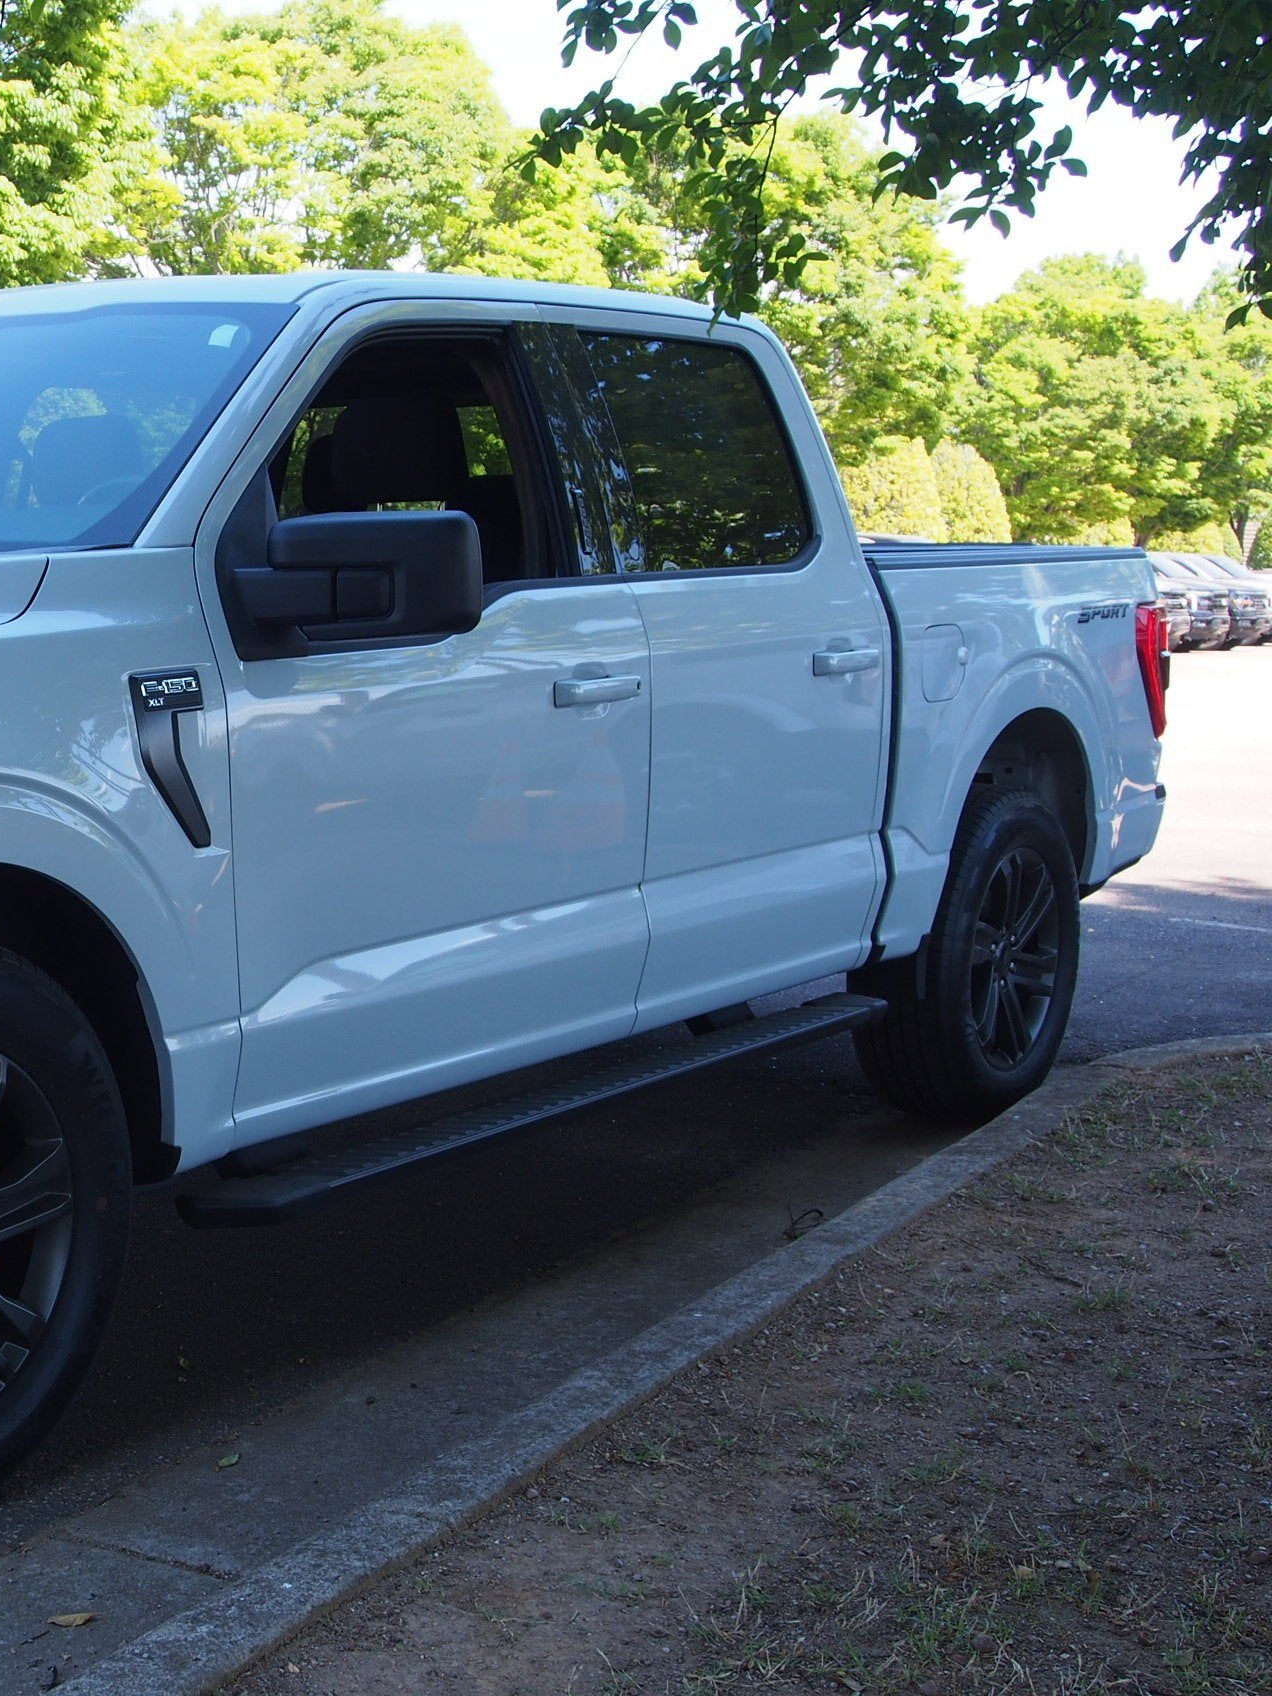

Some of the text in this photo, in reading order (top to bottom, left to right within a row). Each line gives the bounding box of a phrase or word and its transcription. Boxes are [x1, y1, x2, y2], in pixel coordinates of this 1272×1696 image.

[1077, 604, 1130, 624] SPORT
[140, 676, 200, 697] F-150
[148, 697, 165, 707] XLT
